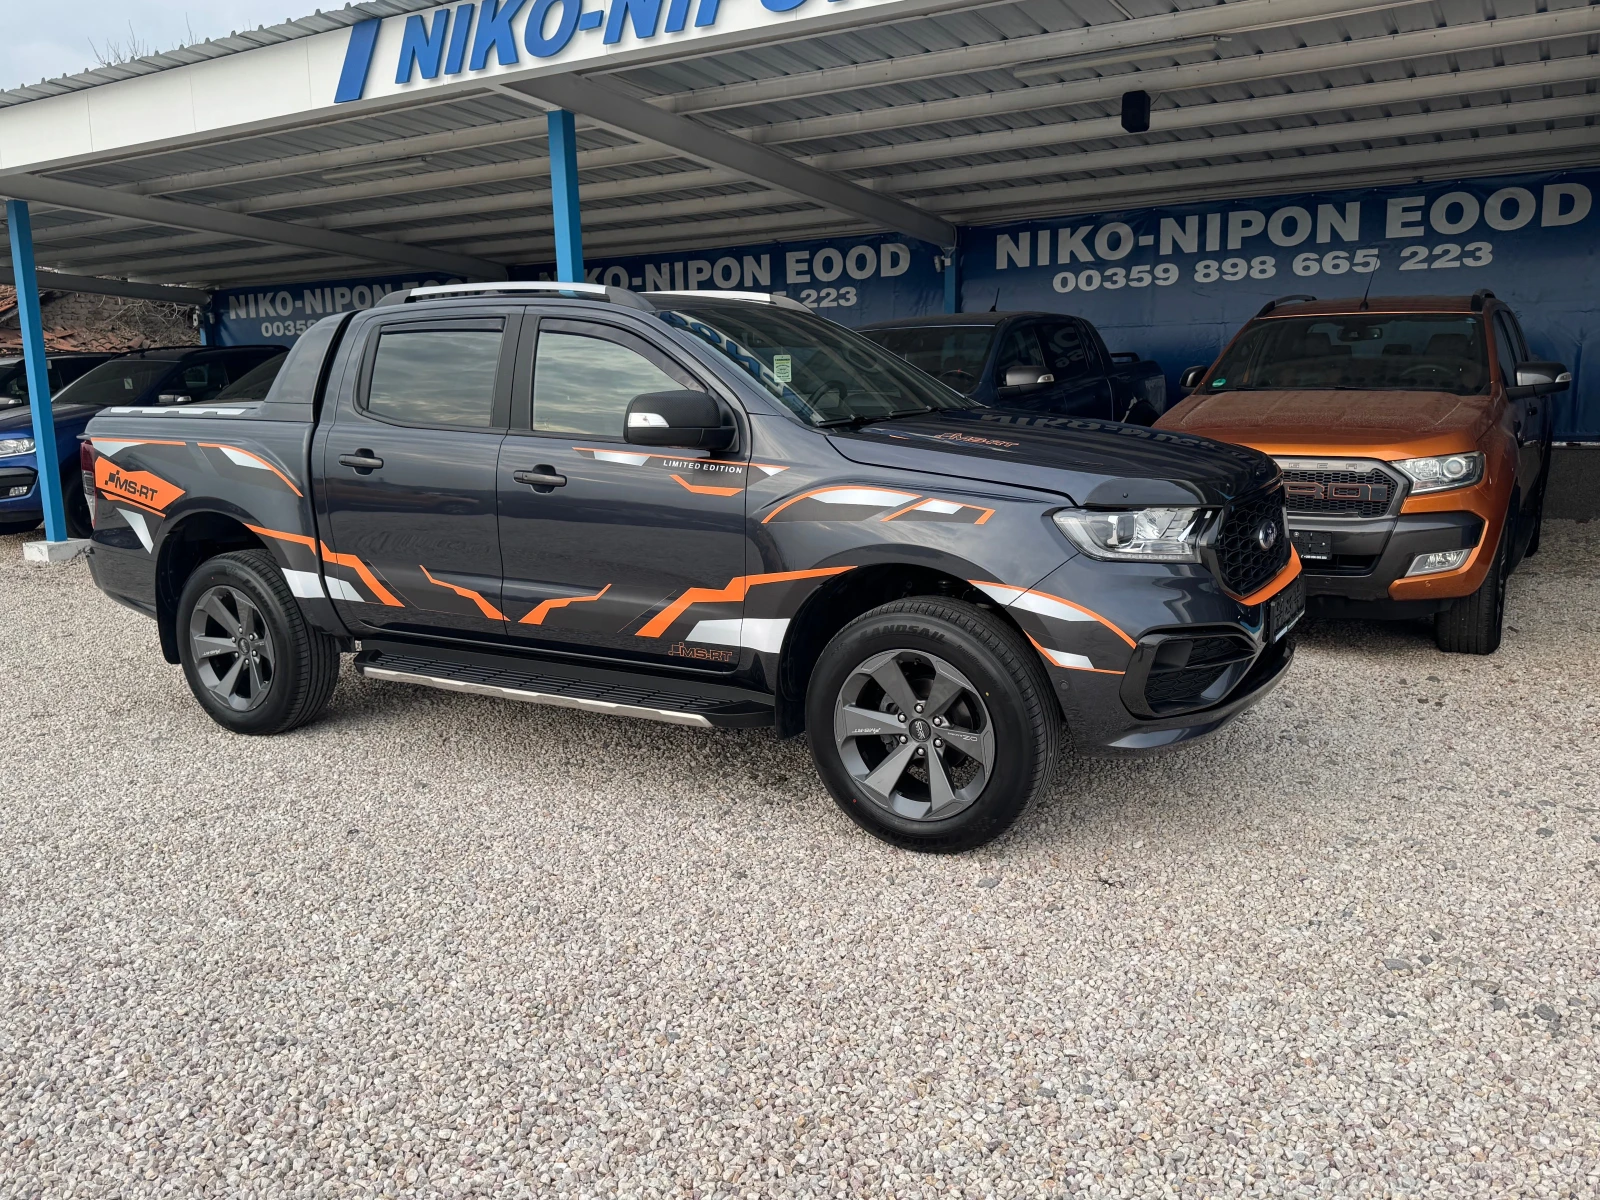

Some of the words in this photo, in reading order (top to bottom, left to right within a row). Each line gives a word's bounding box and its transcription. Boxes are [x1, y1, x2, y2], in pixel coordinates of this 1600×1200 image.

[996, 201, 1361, 270] NIKO-NIPON
[1385, 182, 1592, 239] EOOD
[785, 242, 910, 285] EOOD
[1052, 263, 1180, 293] 00359
[1194, 255, 1277, 283] 898
[1292, 248, 1381, 276] 665
[1399, 241, 1494, 271] 223
[799, 286, 858, 308] 223
[663, 459, 701, 470] LIMITED
[703, 463, 743, 474] EDITION
